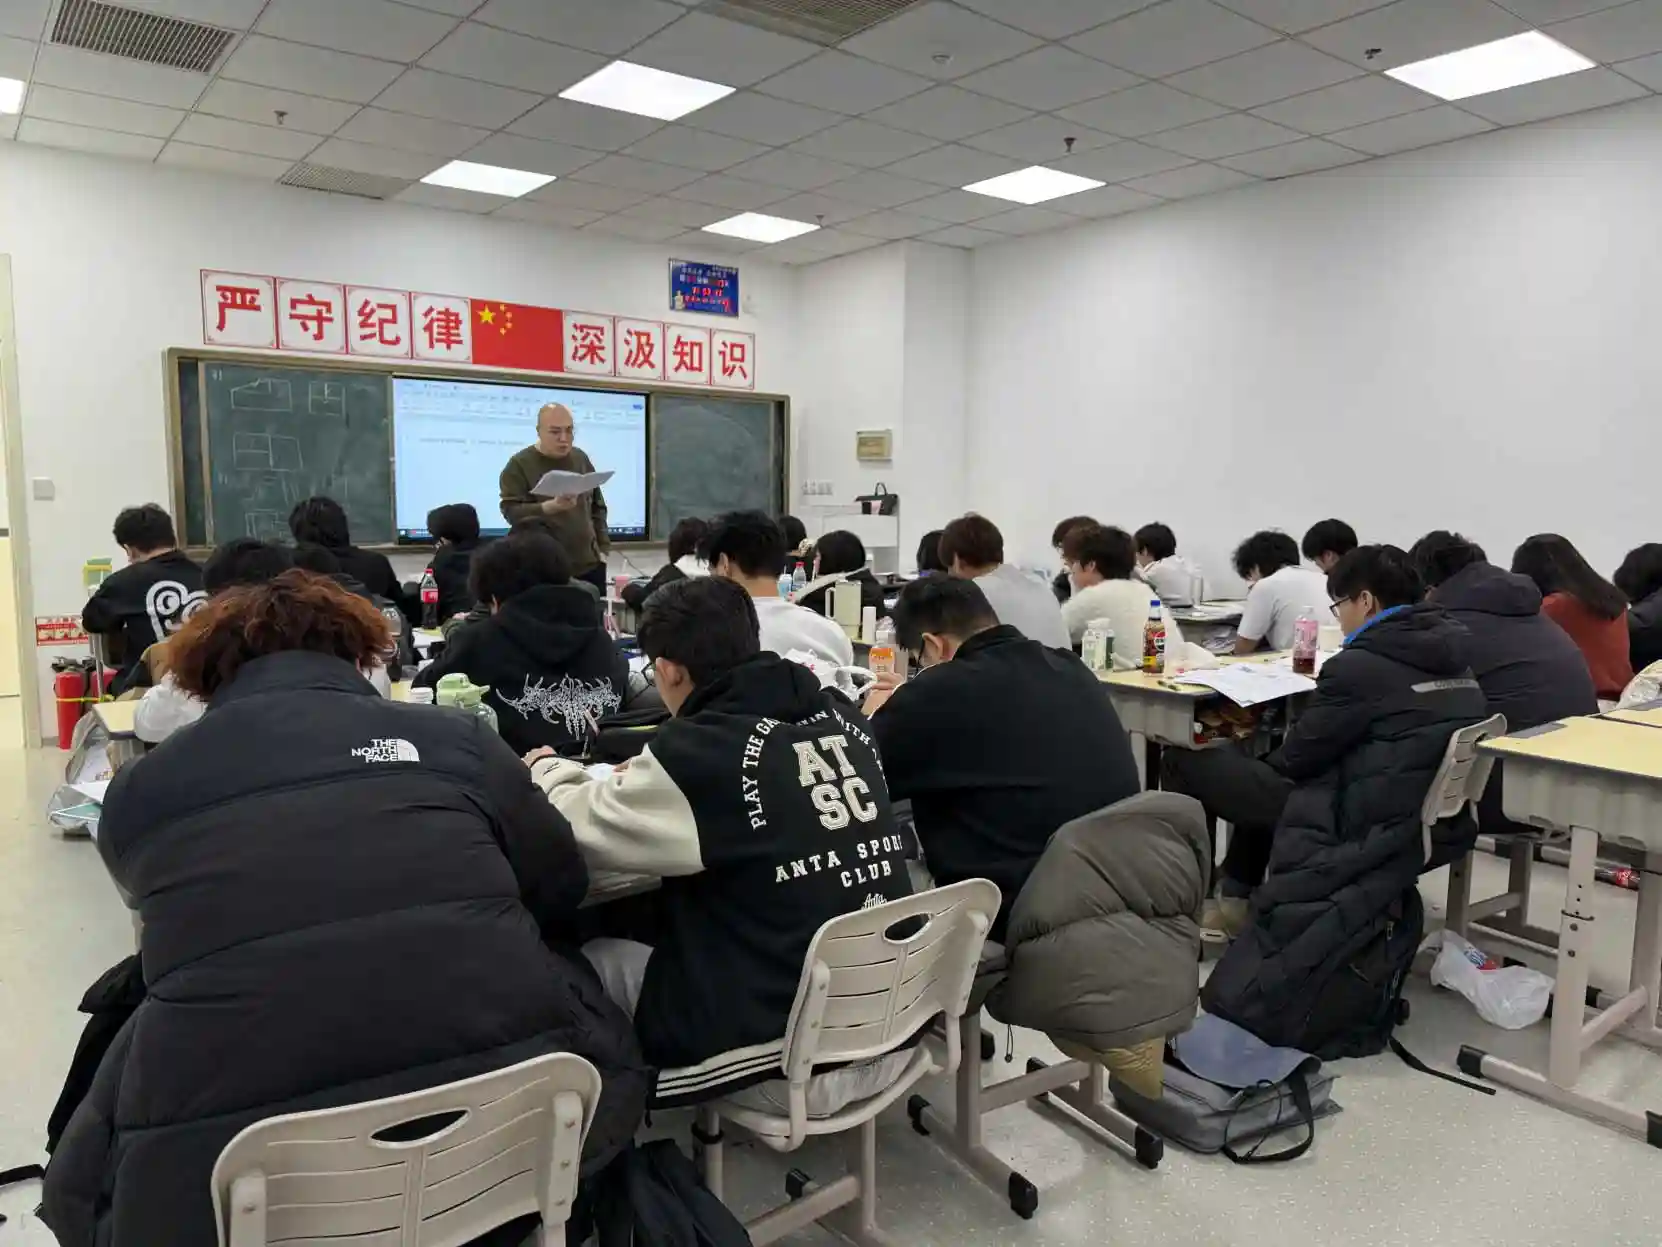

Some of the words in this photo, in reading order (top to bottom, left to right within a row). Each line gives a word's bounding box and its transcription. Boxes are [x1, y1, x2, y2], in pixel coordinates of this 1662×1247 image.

[215, 284, 465, 352] 严守纪律
[571, 322, 748, 380] 深汲知识
[370, 738, 398, 748] THE
[755, 717, 781, 735] GA
[351, 745, 398, 757] NORTH
[365, 753, 399, 764] FACE
[743, 734, 765, 768] THE
[791, 734, 857, 787] AT
[742, 775, 767, 829] PLAY
[810, 776, 879, 831] SC
[774, 850, 842, 883] ANTA
[856, 833, 903, 860] SPOR
[839, 860, 892, 888] CLUB
